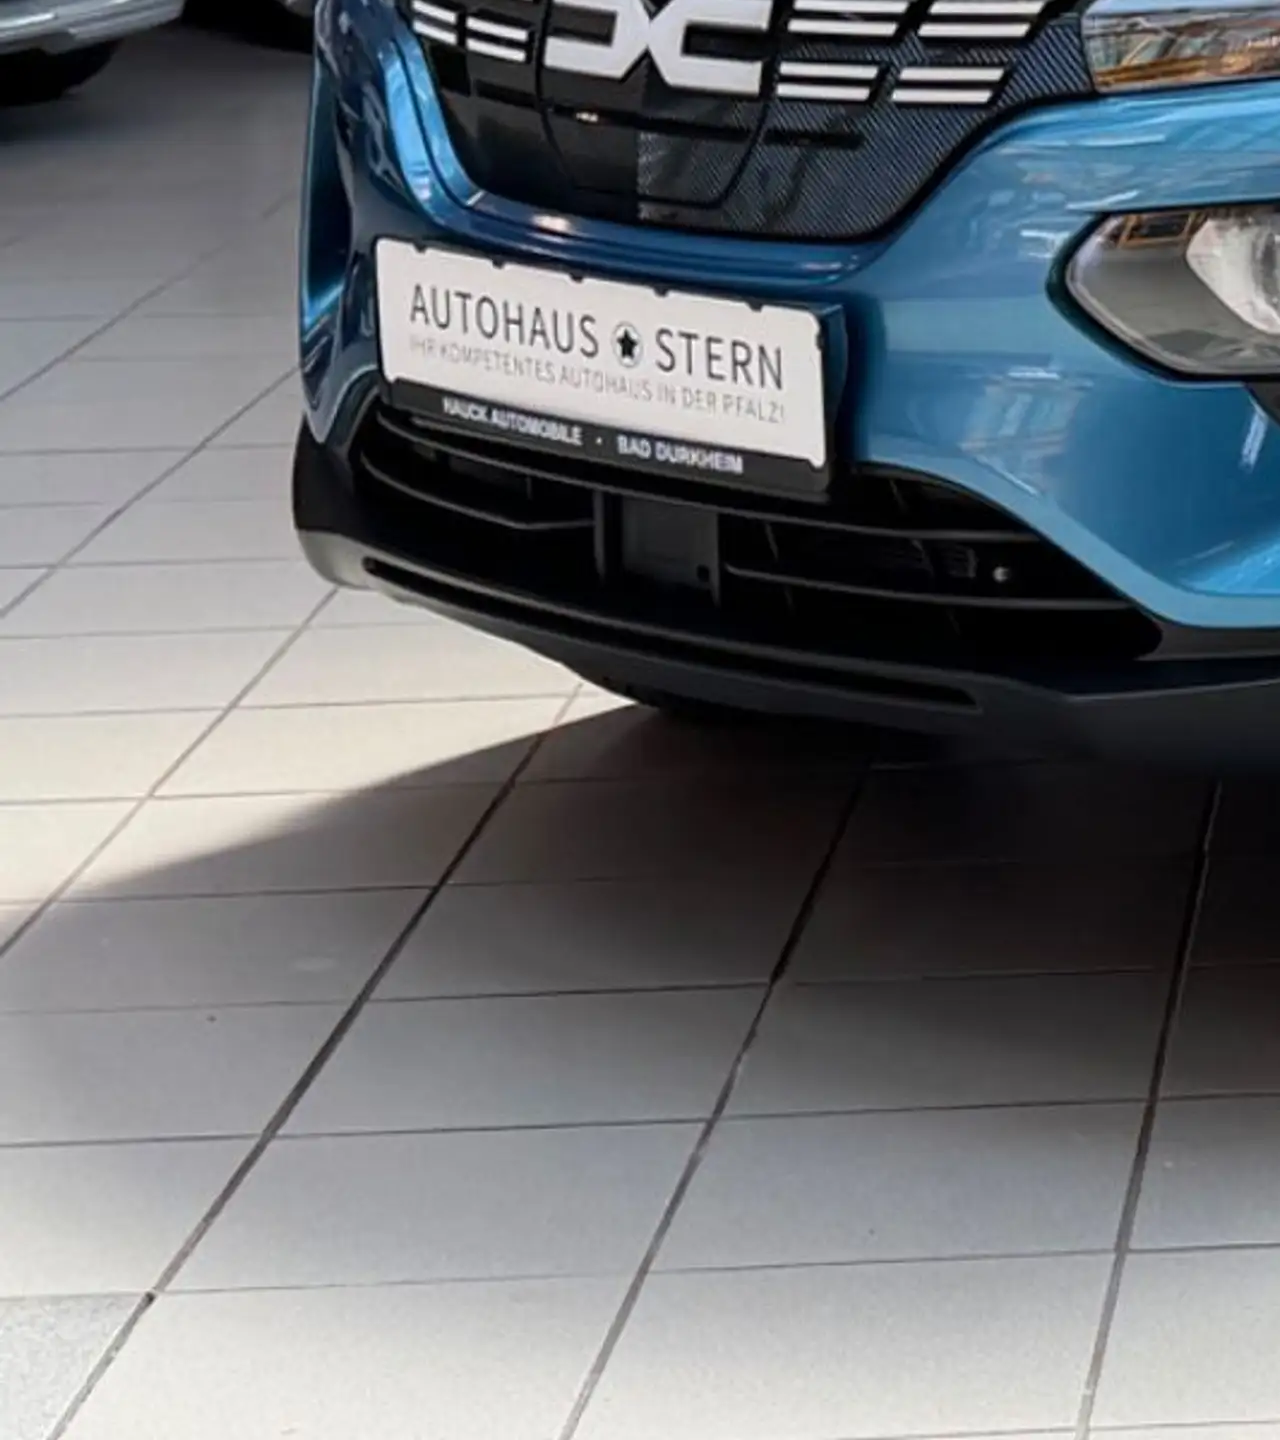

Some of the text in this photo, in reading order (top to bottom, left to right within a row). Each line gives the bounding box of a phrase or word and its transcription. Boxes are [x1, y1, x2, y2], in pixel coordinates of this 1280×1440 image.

[410, 283, 783, 391] AUTOHAUS STERN
[440, 341, 556, 384] KOMPETENTES
[558, 364, 653, 402] AUTOHAUS
[657, 382, 676, 405] IN
[682, 386, 717, 414] DER
[491, 408, 583, 446] AUTOMOBILE
[617, 434, 652, 459] BAD
